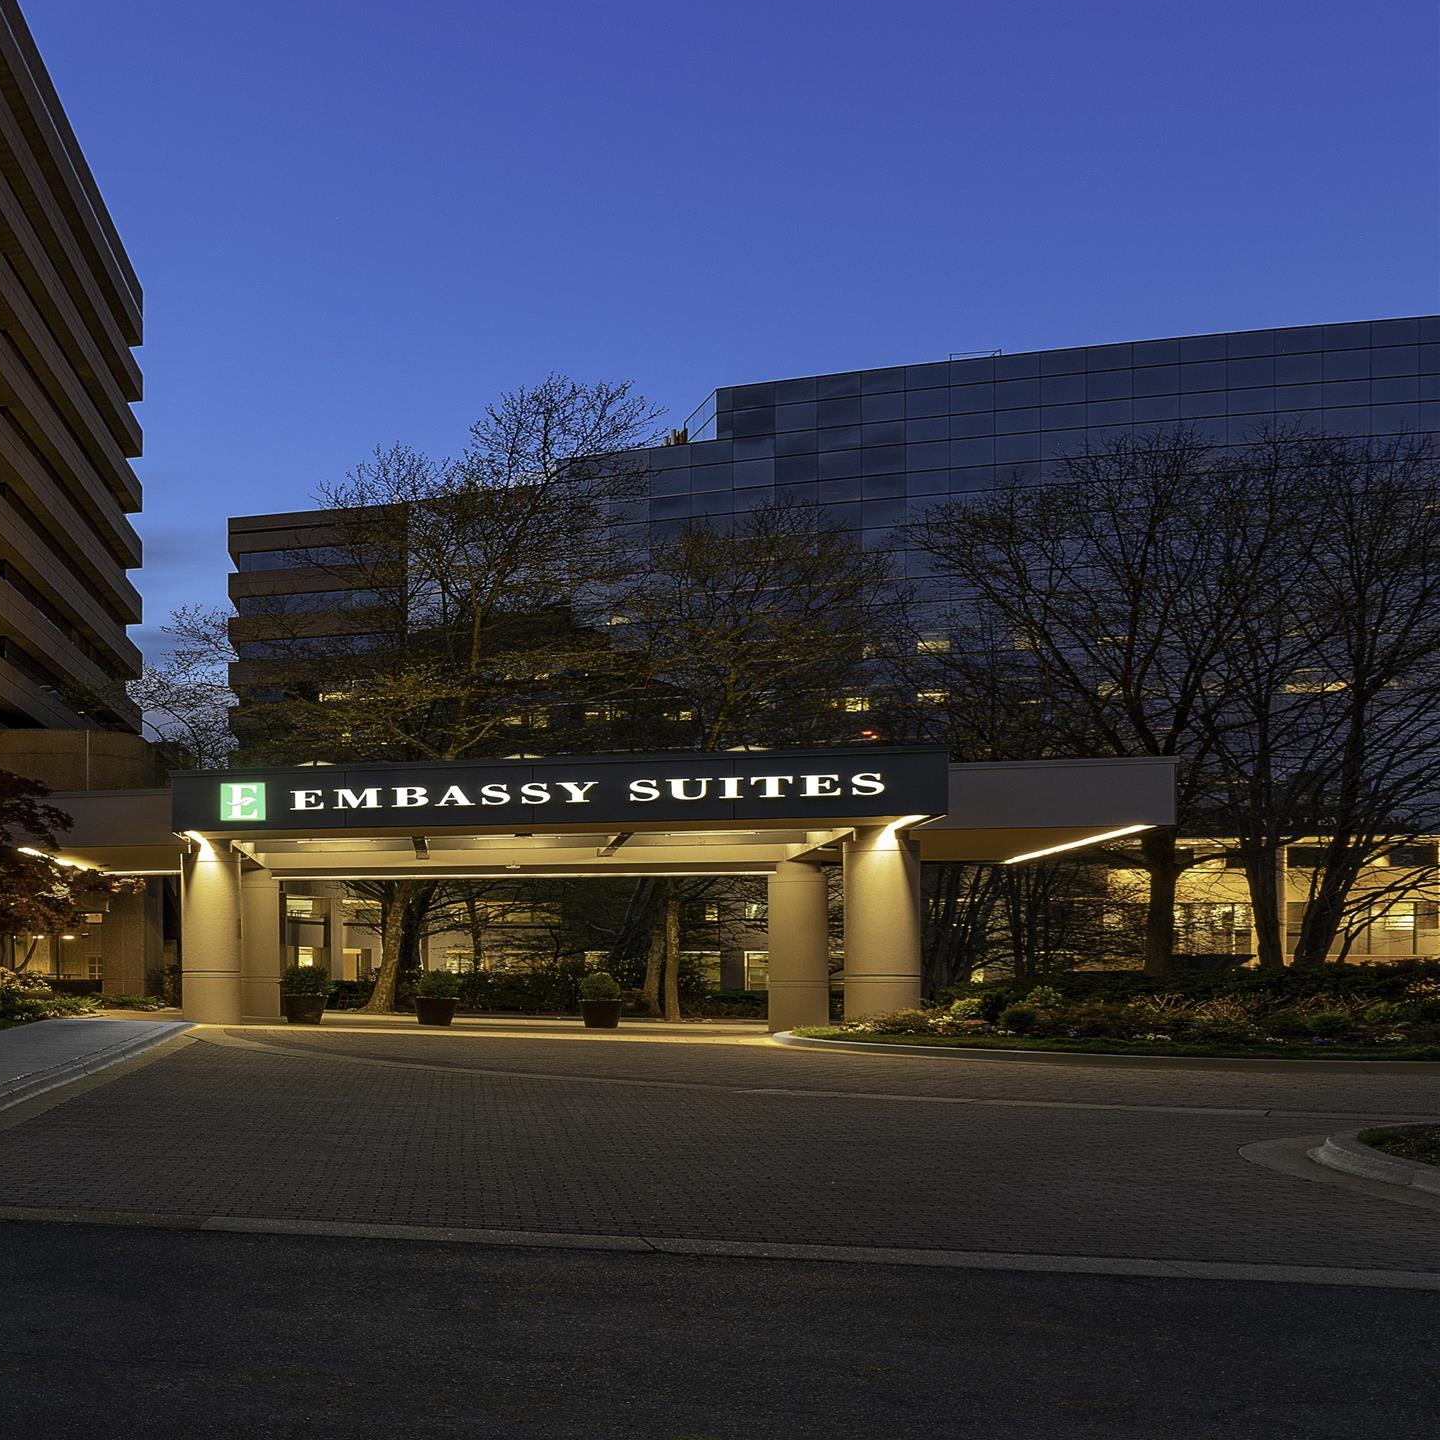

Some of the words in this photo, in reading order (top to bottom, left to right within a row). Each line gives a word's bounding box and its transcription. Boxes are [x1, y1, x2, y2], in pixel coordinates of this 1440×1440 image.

[227, 784, 258, 819] E
[289, 781, 599, 811] EMBASSY
[629, 772, 885, 802] SUITES
